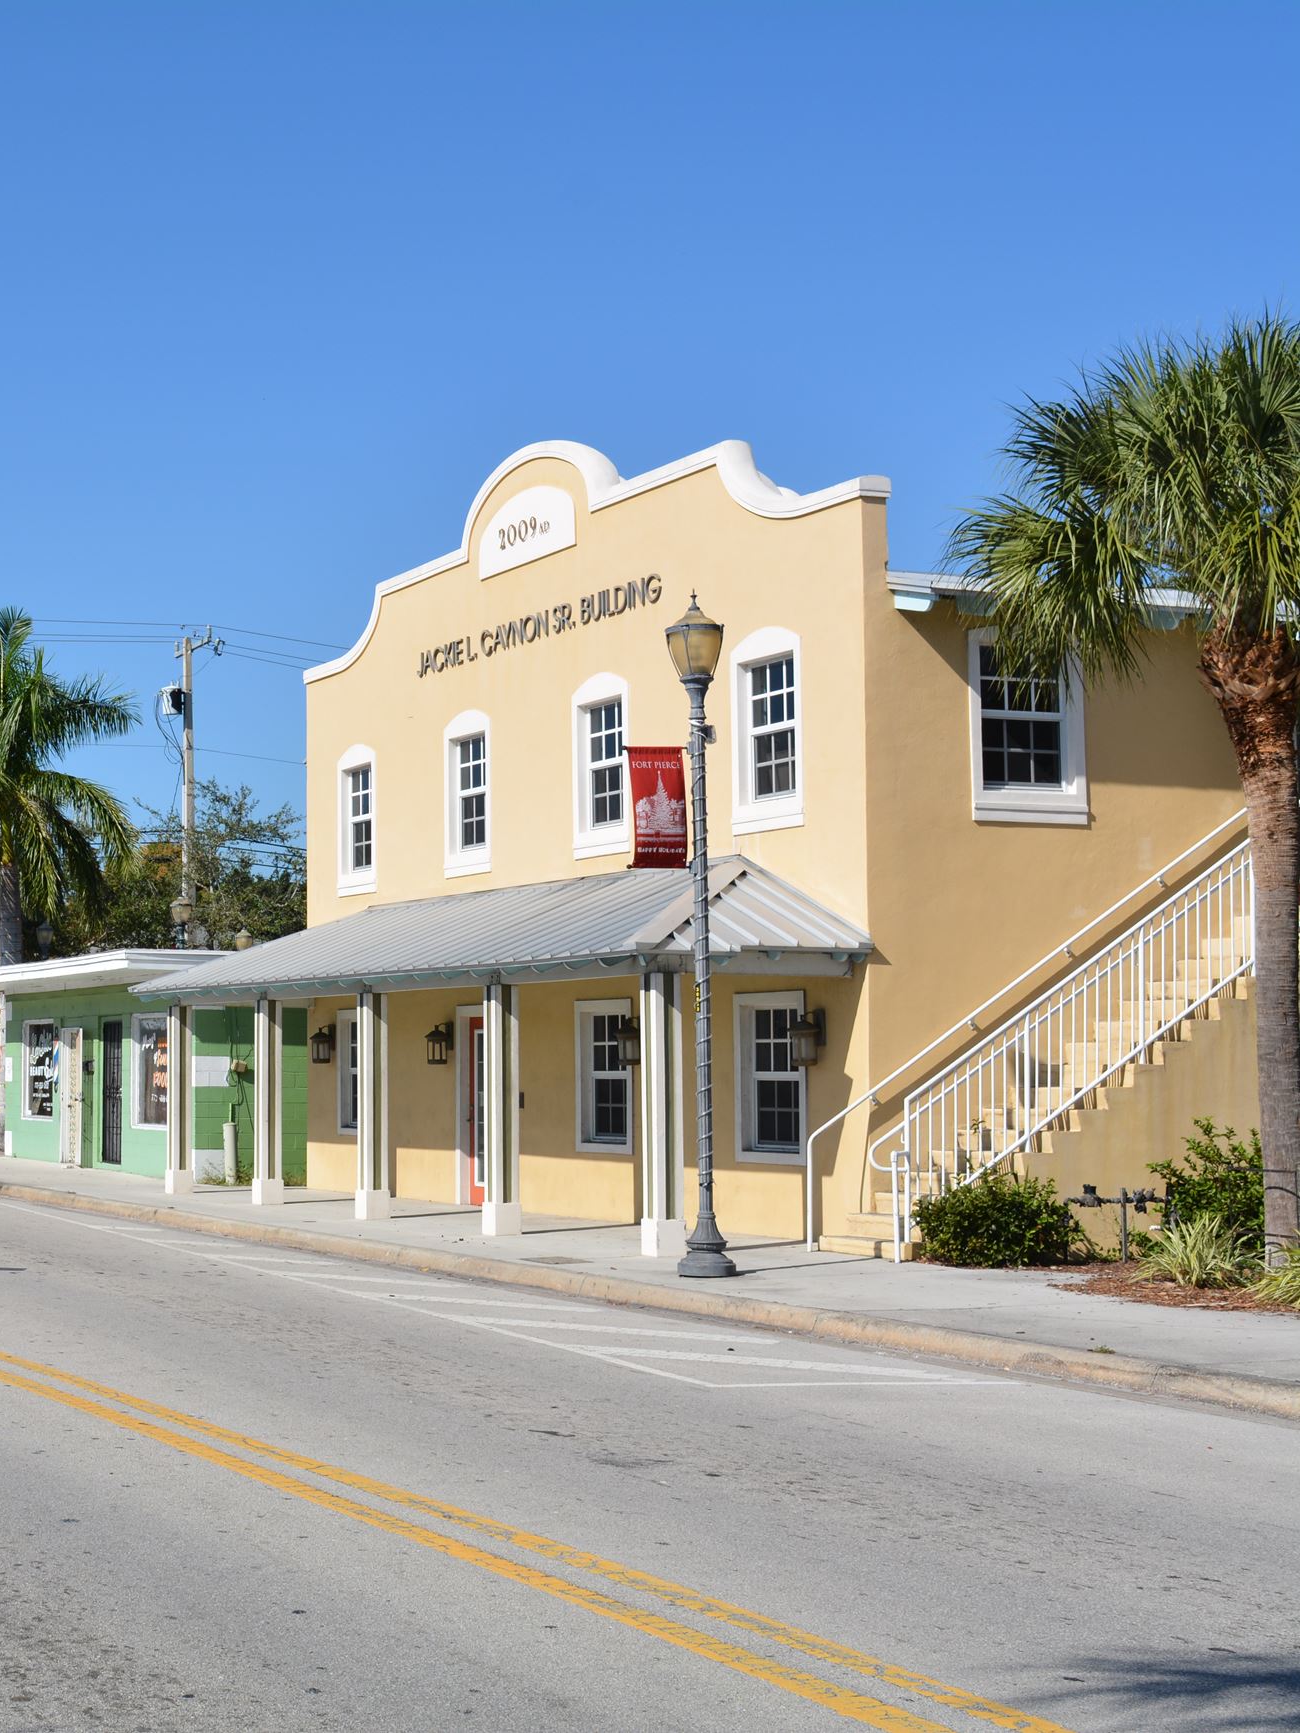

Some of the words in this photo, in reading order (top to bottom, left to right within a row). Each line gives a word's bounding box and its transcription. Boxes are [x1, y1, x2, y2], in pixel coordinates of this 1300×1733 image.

[498, 517, 537, 550] 2009
[417, 638, 464, 678] JACKIE
[466, 636, 478, 661] L.
[480, 609, 549, 657] CAYNON
[552, 602, 576, 635] SR.
[580, 573, 662, 625] BUILDING
[632, 761, 653, 769] FORT
[654, 761, 680, 769] PIERCE
